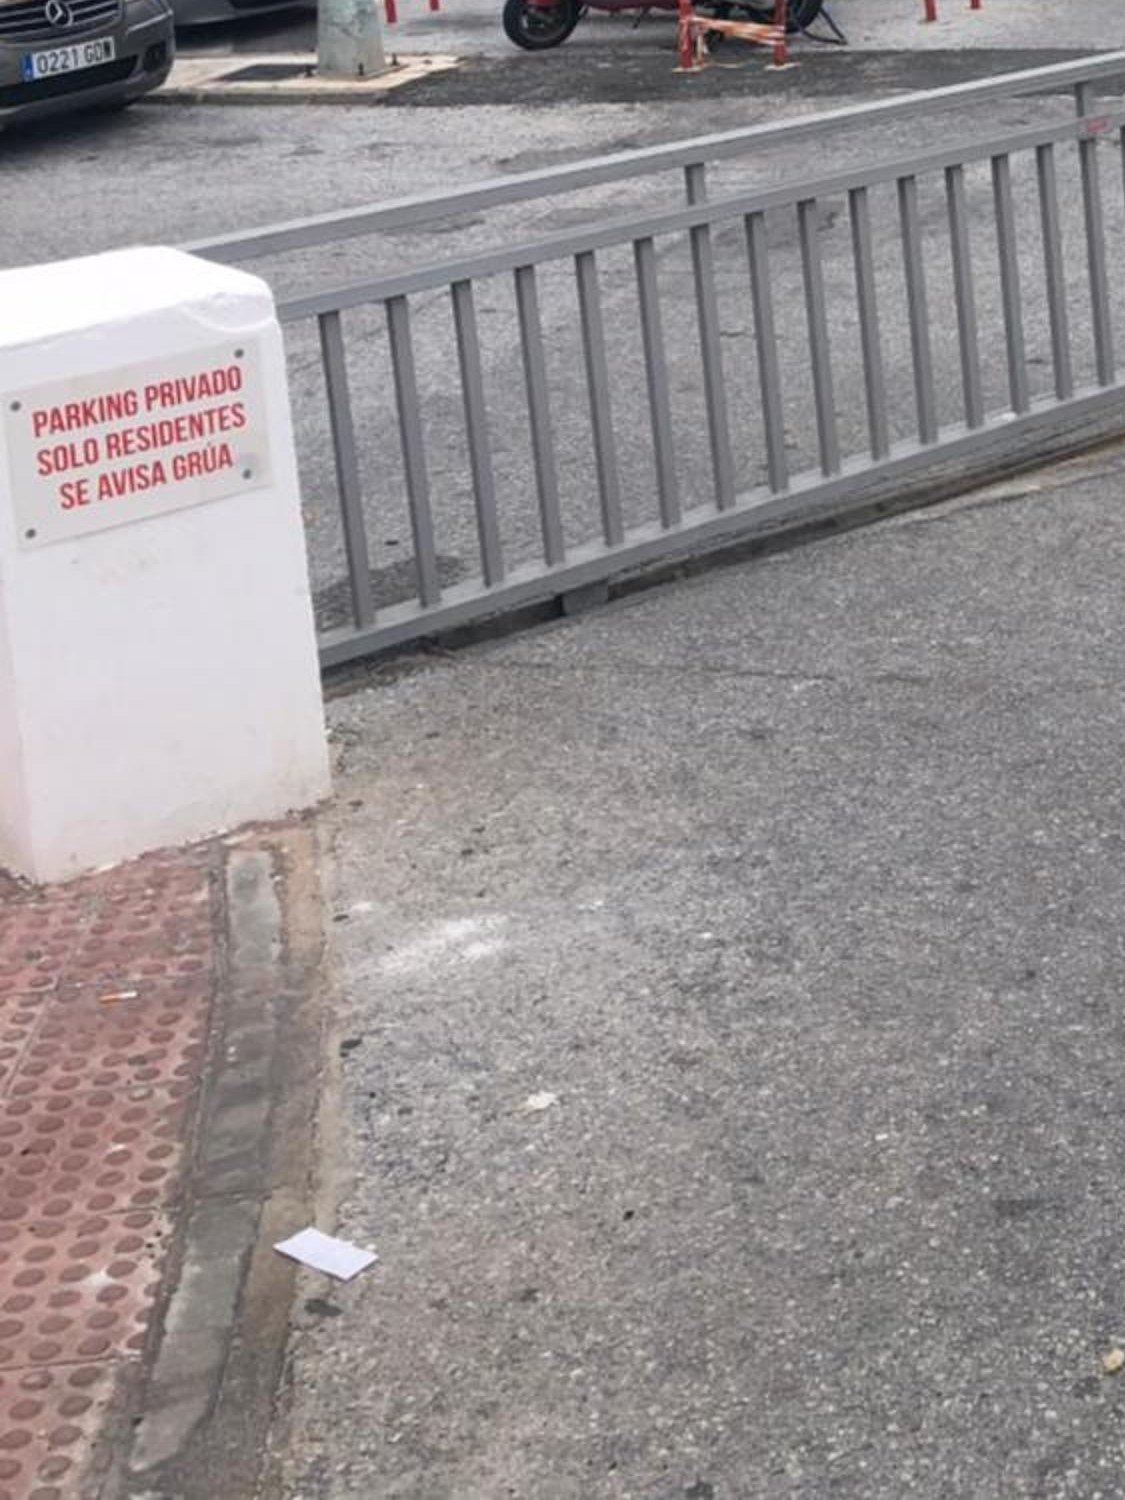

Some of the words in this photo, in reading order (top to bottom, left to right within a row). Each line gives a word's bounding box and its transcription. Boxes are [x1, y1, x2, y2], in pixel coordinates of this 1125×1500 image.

[36, 47, 79, 75] 0221
[32, 389, 139, 438] PARKING
[144, 365, 243, 412] PRIVADO
[36, 438, 99, 476] SOLO
[105, 403, 247, 460] RESIDENTES
[59, 479, 91, 510] SE
[97, 460, 167, 501] AVISA
[172, 441, 234, 481] GRÚA
